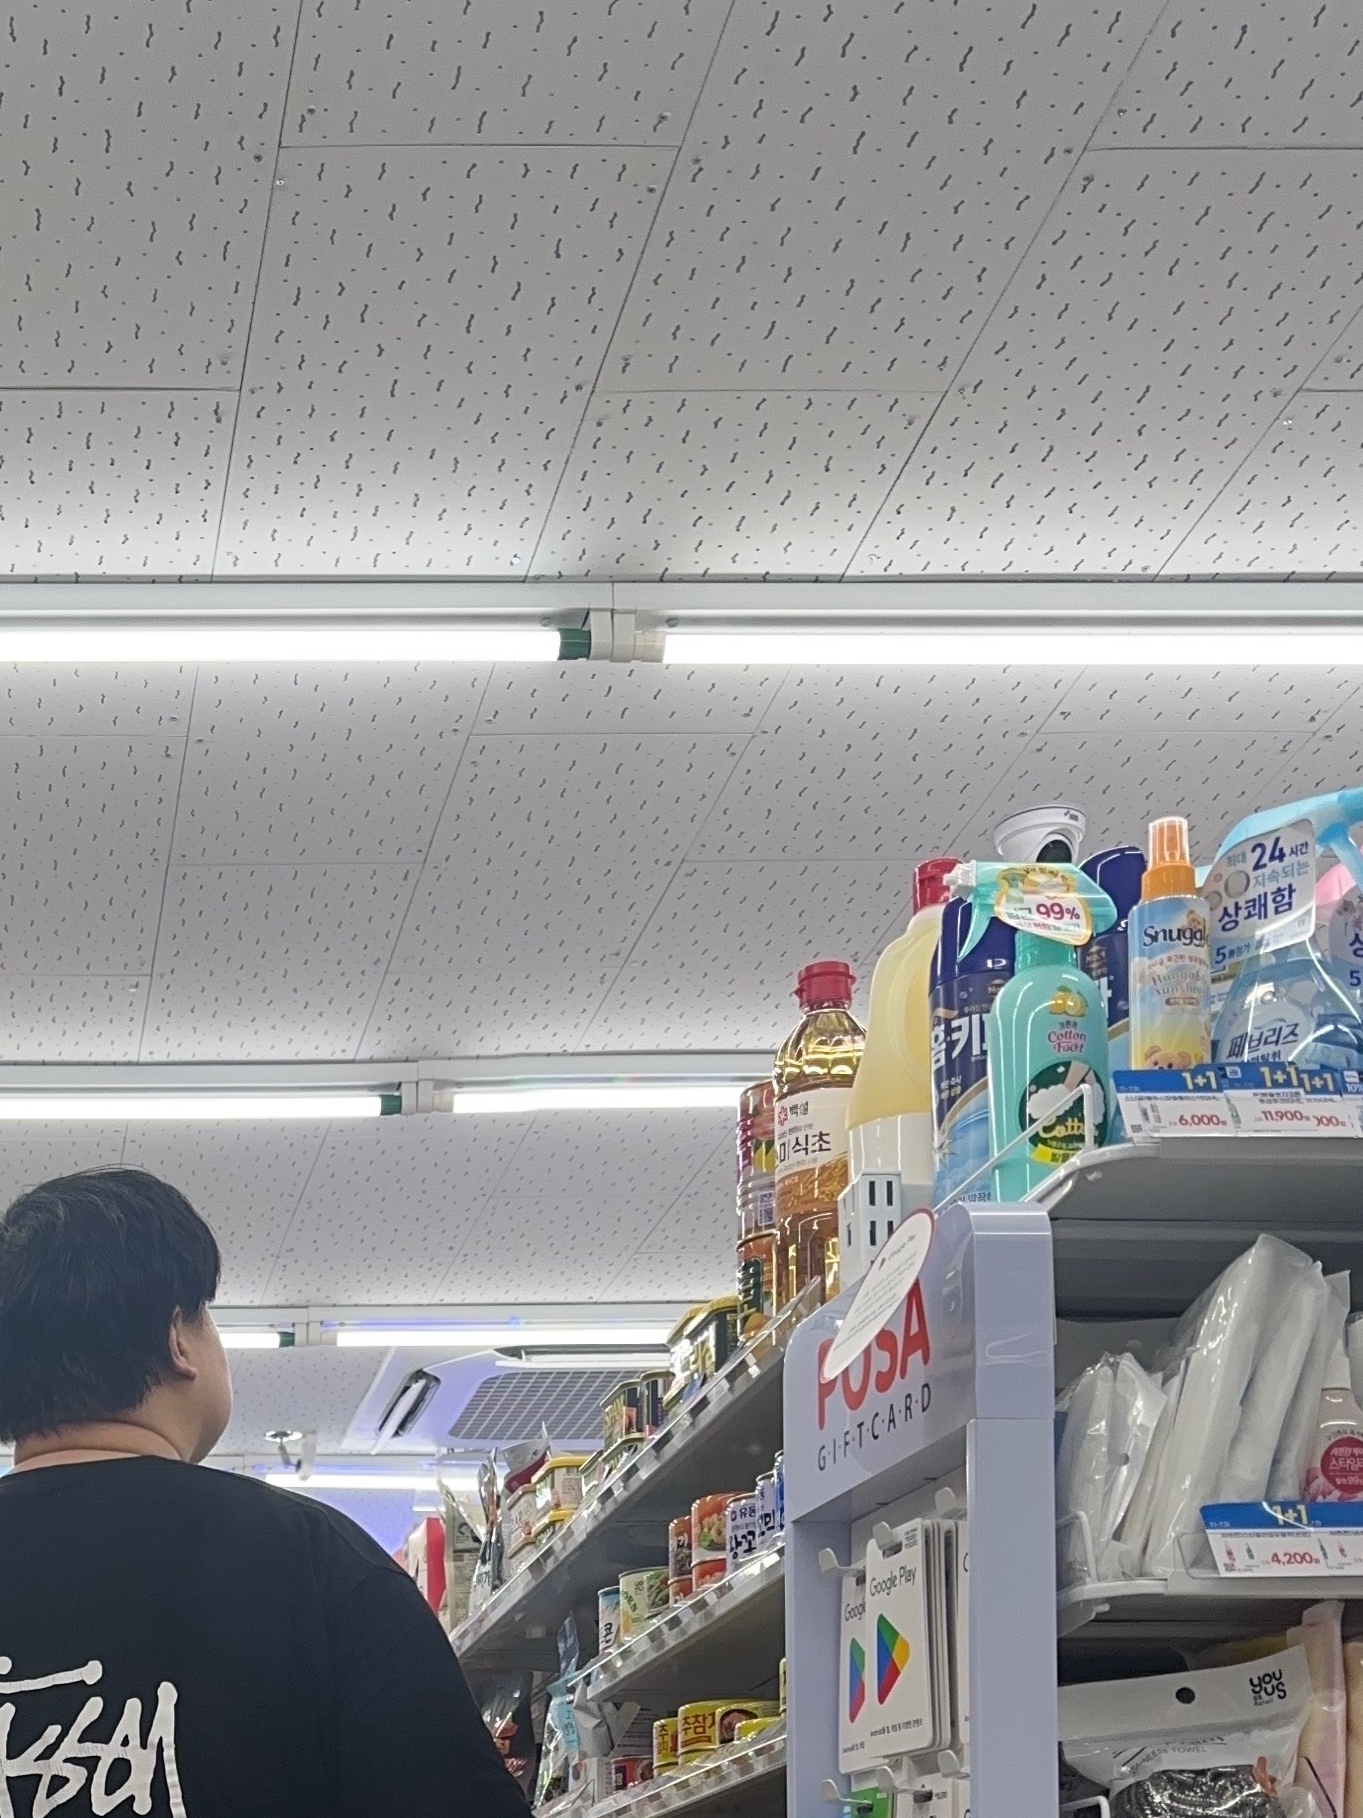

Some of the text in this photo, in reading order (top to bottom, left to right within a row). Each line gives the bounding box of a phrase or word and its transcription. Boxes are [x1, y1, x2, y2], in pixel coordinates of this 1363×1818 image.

[1251, 836, 1287, 873] 24
[1288, 841, 1310, 859] 시간
[1253, 859, 1311, 889] 지속되는
[1035, 902, 1081, 923] 99%
[1217, 882, 1297, 933] 상쾌함
[1047, 1029, 1087, 1045] Cotton
[1226, 1022, 1300, 1060] 페브리즈
[1182, 1070, 1218, 1091] 1+1
[1260, 1065, 1299, 1088] 1+1
[1300, 1072, 1335, 1093] 1+1
[789, 1100, 809, 1118] 백설
[778, 1130, 832, 1164] 미식초
[817, 1276, 931, 1432] POSA
[1272, 1504, 1308, 1526] 1+1
[869, 1565, 918, 1598] Google Play
